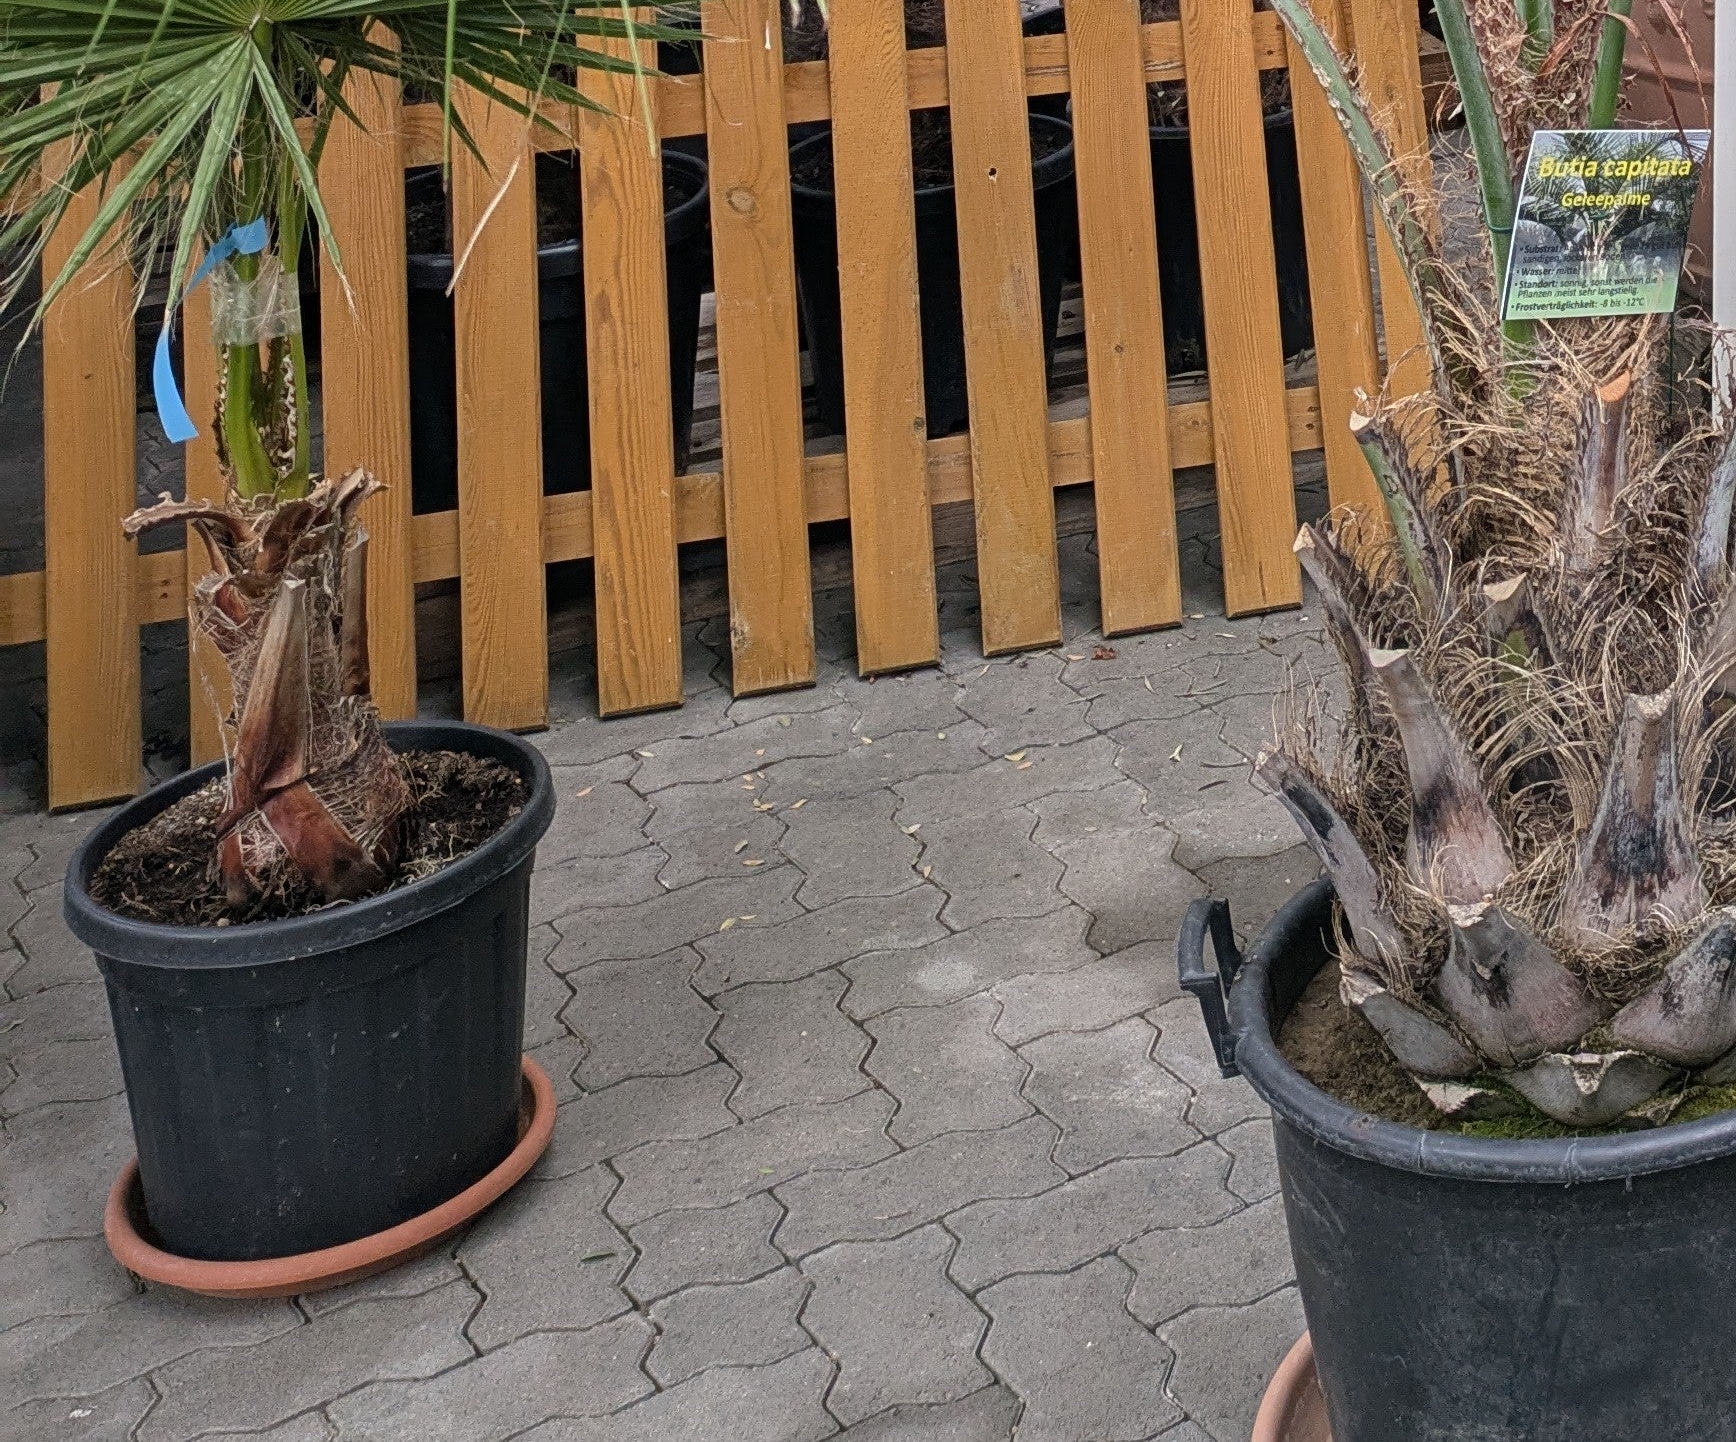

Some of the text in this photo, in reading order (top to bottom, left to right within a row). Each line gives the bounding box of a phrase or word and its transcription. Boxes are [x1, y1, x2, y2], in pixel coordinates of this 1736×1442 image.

[1538, 155, 1693, 181] Butia capitata
[1561, 192, 1651, 208] Geleepalme
